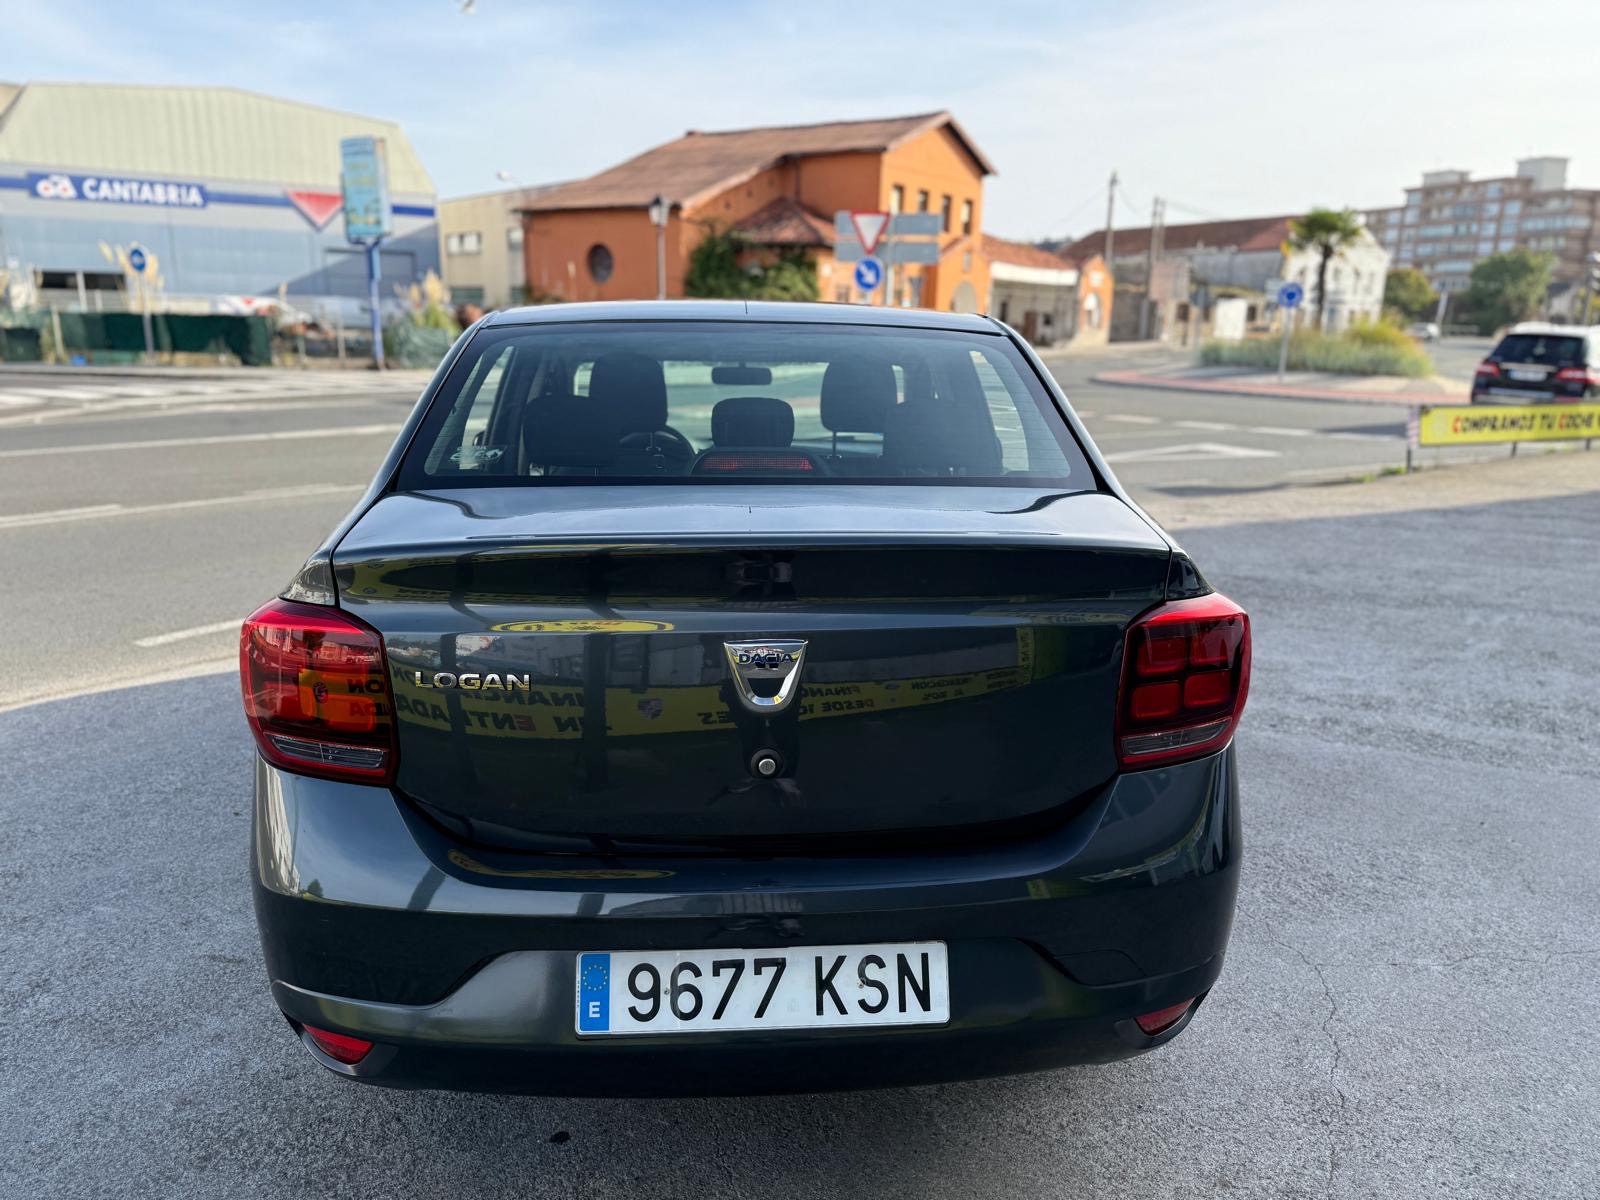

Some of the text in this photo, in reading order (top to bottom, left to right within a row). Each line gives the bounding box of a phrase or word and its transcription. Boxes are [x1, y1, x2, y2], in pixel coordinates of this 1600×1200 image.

[82, 177, 204, 207] CANTABRIA
[1452, 414, 1535, 434] COMPRAMOS
[1540, 414, 1555, 430] TU
[738, 653, 794, 665] DACIA
[414, 671, 531, 692] LOGAN
[627, 957, 787, 1023] 9677
[814, 952, 932, 1016] KSN
[588, 1001, 601, 1018] E
